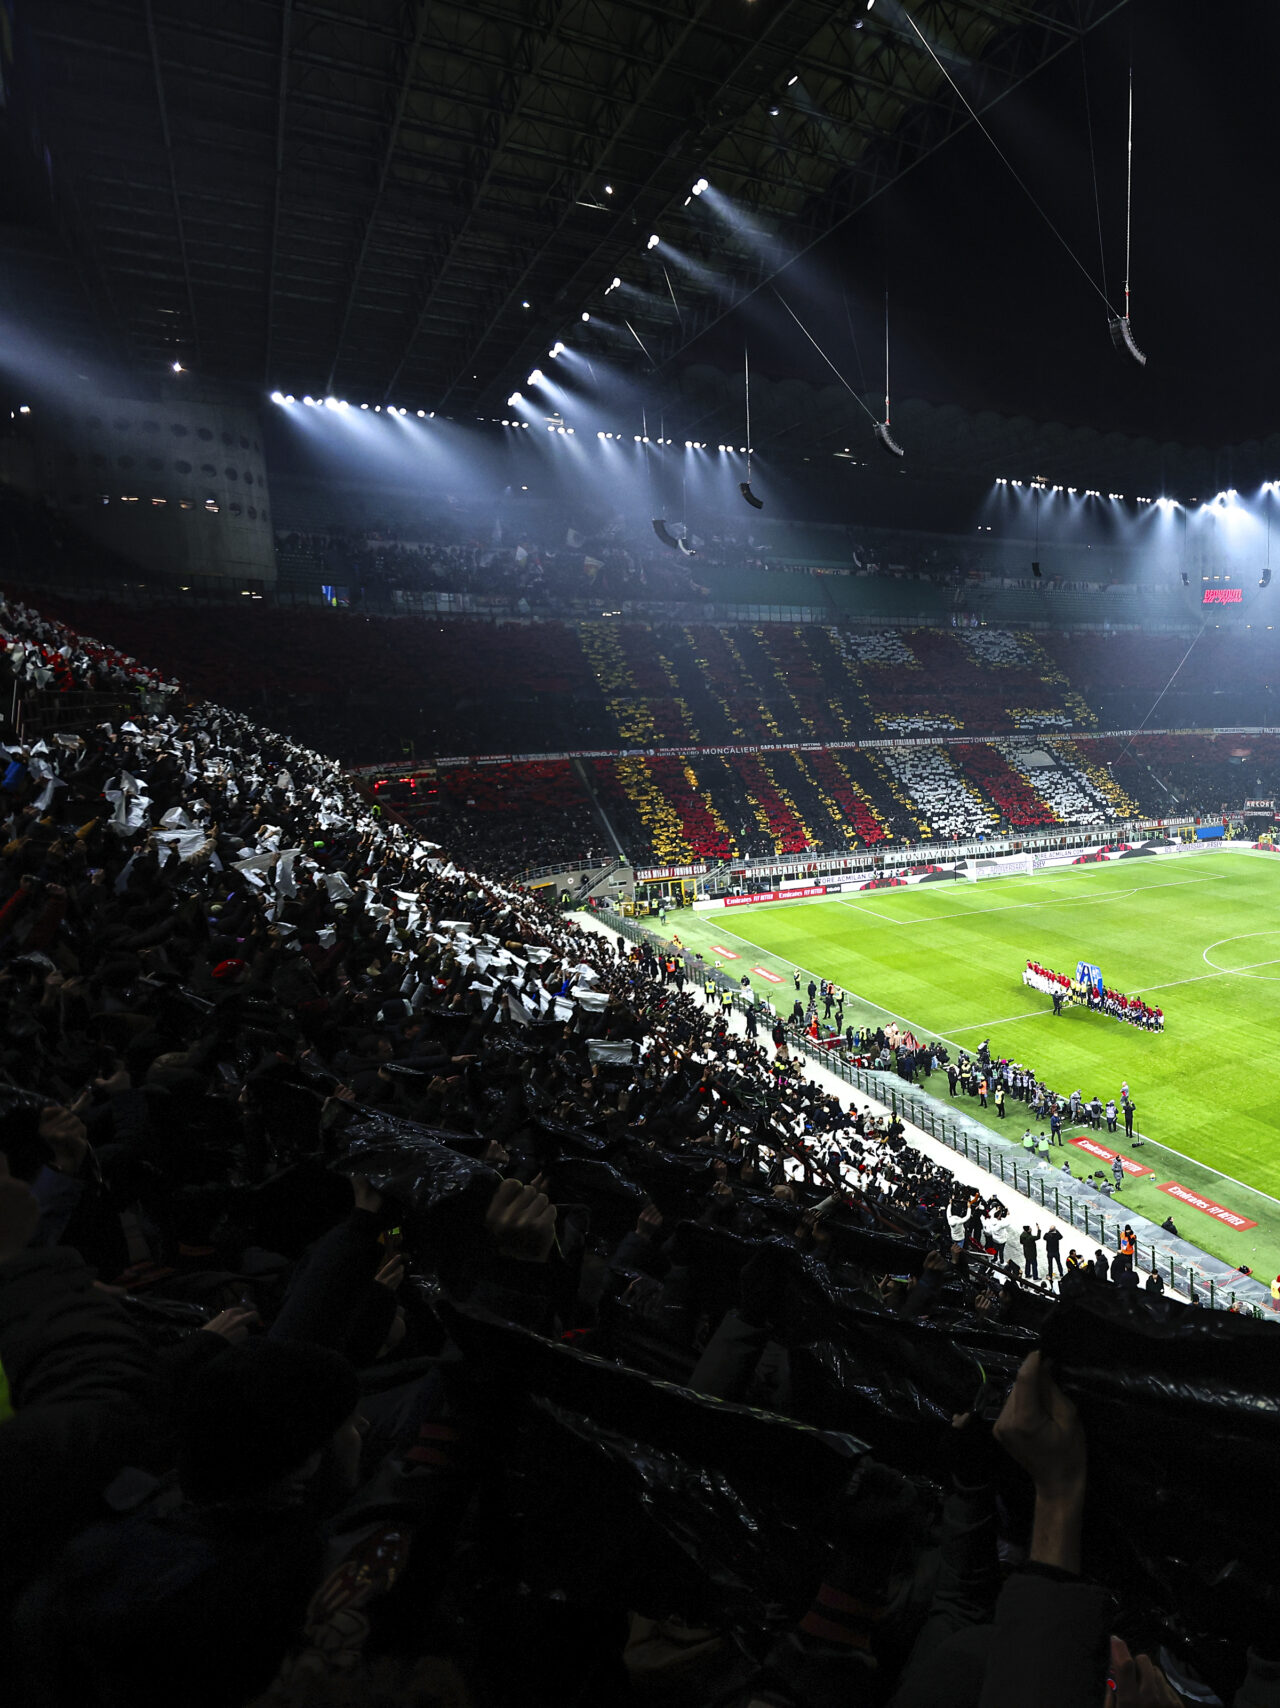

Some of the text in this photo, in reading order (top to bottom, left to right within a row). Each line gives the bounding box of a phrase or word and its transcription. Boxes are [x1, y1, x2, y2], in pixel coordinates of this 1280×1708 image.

[702, 746, 758, 755] MONCALIERI
[859, 739, 894, 747] ASSOCIAZIONE
[900, 845, 995, 860] FONDAZIONE MILAN
[637, 871, 652, 880] CASA
[652, 869, 670, 878] MILAN
[674, 866, 692, 876] JUNIOR
[692, 864, 706, 874] CLUB
[745, 867, 771, 878] MILAN
[772, 864, 808, 875] ACADEMY
[816, 860, 845, 871] SCUOLA
[846, 857, 873, 868] CALCIO
[726, 897, 752, 905] Emirates
[779, 891, 802, 899] Emirates
[1077, 1139, 1113, 1160] Emirates
[1168, 1186, 1210, 1209] Emirates
[1216, 1211, 1246, 1227] BETTER
